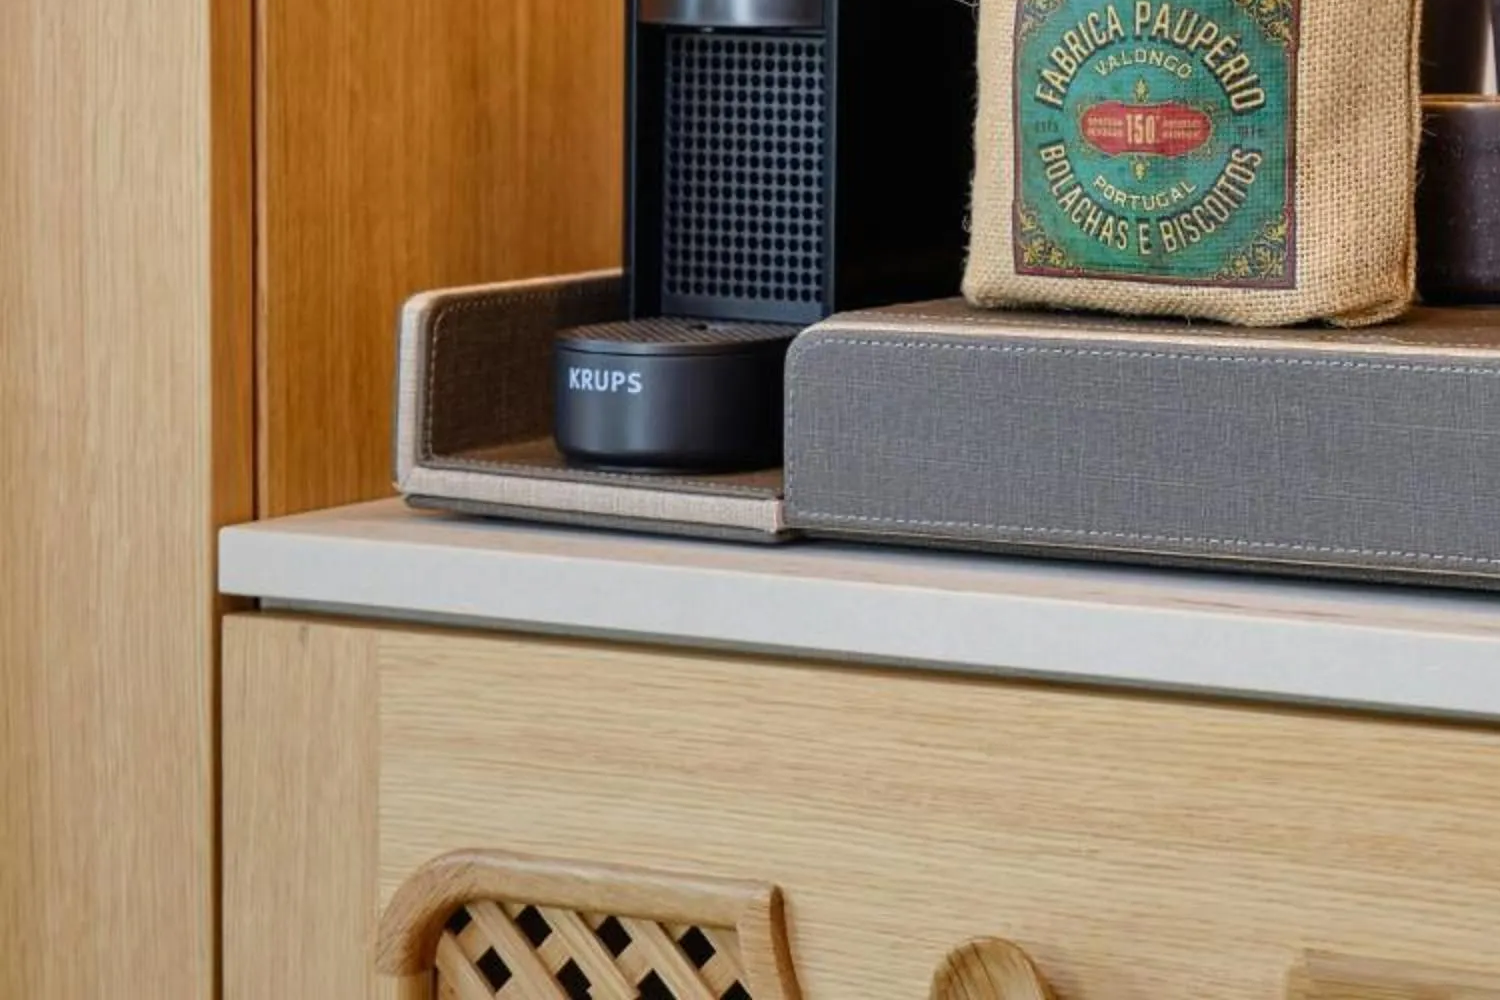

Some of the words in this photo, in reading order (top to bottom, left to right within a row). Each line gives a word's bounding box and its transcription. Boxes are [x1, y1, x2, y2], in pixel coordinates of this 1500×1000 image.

[1094, 48, 1192, 78] VALONGO
[1040, 144, 1129, 250] BOLACHAS
[1138, 222, 1151, 255] E
[1159, 148, 1262, 254] BISCOITOS
[1092, 175, 1197, 211] PORTUGAL
[569, 366, 643, 394] KRUPS
